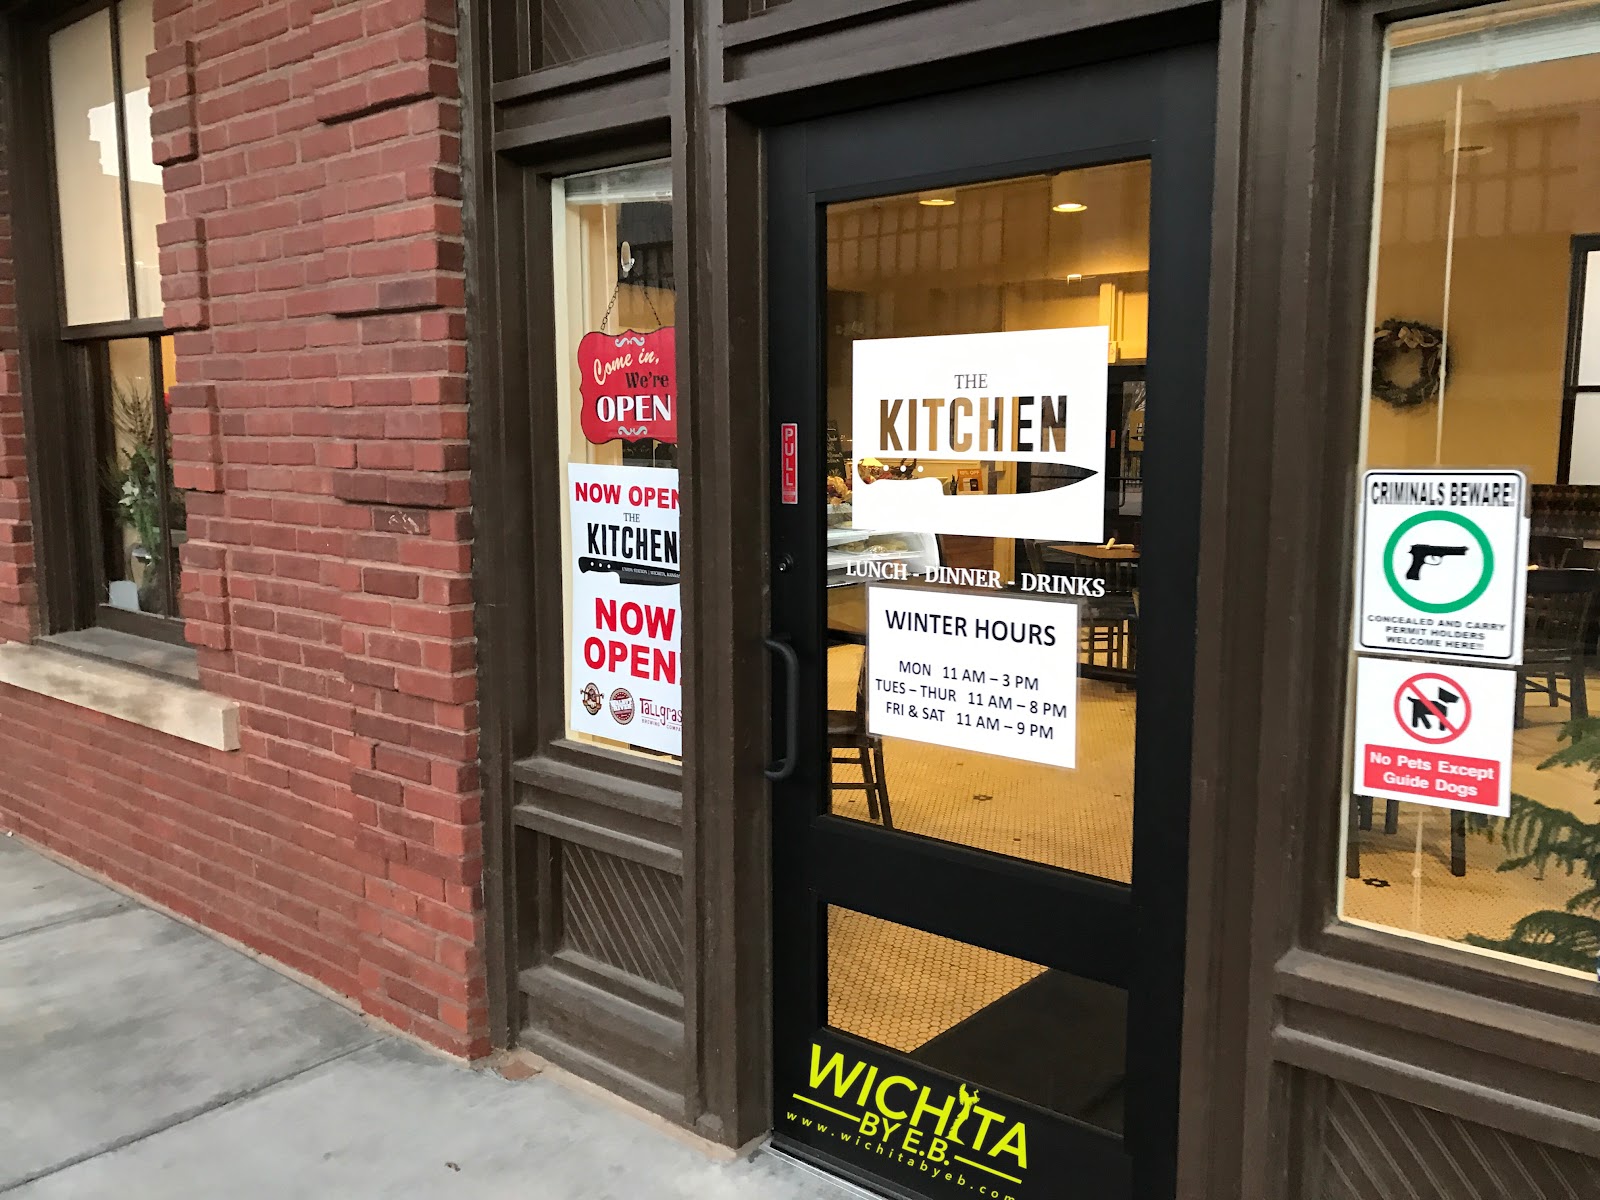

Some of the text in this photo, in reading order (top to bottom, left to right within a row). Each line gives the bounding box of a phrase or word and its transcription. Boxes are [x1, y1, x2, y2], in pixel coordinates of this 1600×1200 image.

[594, 348, 660, 386] Come in,
[625, 372, 668, 388] We're
[954, 374, 988, 390] THE
[596, 394, 672, 422] OPEN
[880, 395, 1068, 452] KITCHEN
[784, 428, 794, 486] PULL
[575, 482, 680, 510] NOW OPEN
[1371, 482, 1446, 506] CRIMINALS
[623, 512, 640, 522] THE
[587, 522, 678, 564] KITCHEN
[846, 559, 908, 580] LUNCH
[924, 565, 1002, 589] DINNER
[1020, 572, 1106, 598] DRINKS
[595, 598, 676, 642] NOW
[885, 610, 1056, 646] WINTER HOURS
[1367, 614, 1506, 631] CONCEALED AND CARRY
[1385, 626, 1486, 640] PERMIT HOLDERS
[1386, 636, 1441, 647] WELCOME
[584, 636, 682, 686] OPEN
[899, 660, 932, 676] MON
[942, 666, 958, 680] 11
[962, 669, 986, 684] AM
[1002, 674, 1010, 686] 3
[1015, 676, 1039, 690] PM
[876, 678, 906, 694] TUES
[920, 685, 956, 702] THUR
[968, 692, 983, 706] 11
[988, 696, 1012, 710] AM
[1030, 701, 1038, 714] 8
[1043, 702, 1067, 718] PM
[886, 702, 904, 716] FRI
[908, 704, 918, 718] &
[922, 708, 945, 722] SAT
[956, 712, 972, 726] 11
[976, 716, 1000, 731] AM
[1016, 722, 1025, 735] 9
[1030, 724, 1054, 740] PM
[1369, 752, 1495, 781] No Pets Except
[1382, 771, 1478, 798] Guide Dogs
